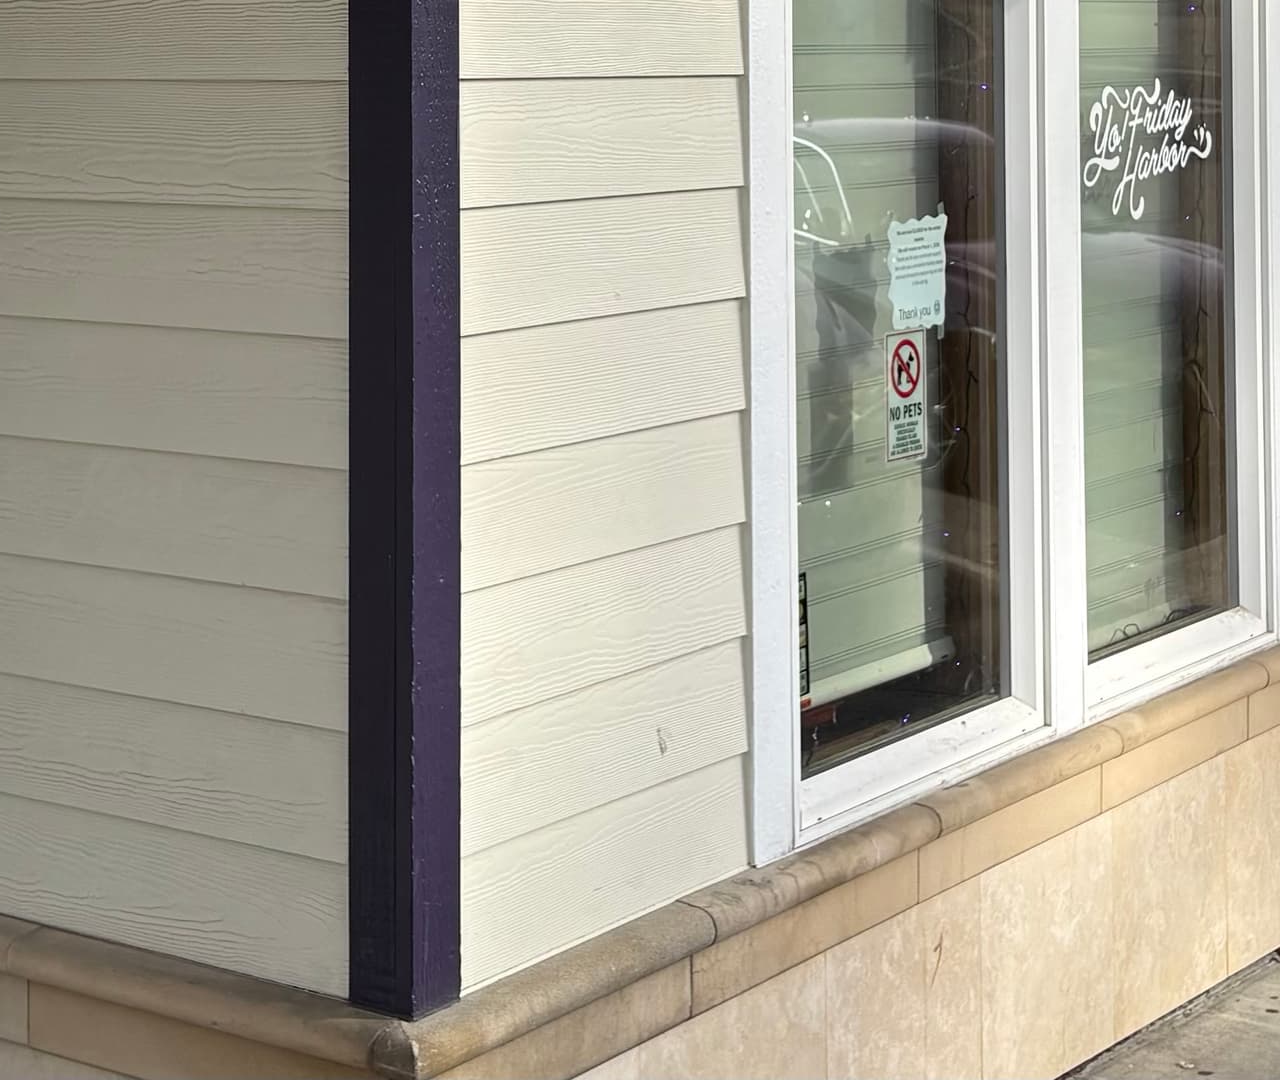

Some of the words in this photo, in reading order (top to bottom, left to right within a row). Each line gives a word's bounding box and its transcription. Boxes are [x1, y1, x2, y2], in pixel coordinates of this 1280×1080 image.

[1083, 101, 1130, 188] Yo!
[1129, 78, 1193, 142] Friday
[1112, 133, 1212, 220] Harbor
[890, 406, 901, 421] NO
[903, 401, 922, 419] PETS
